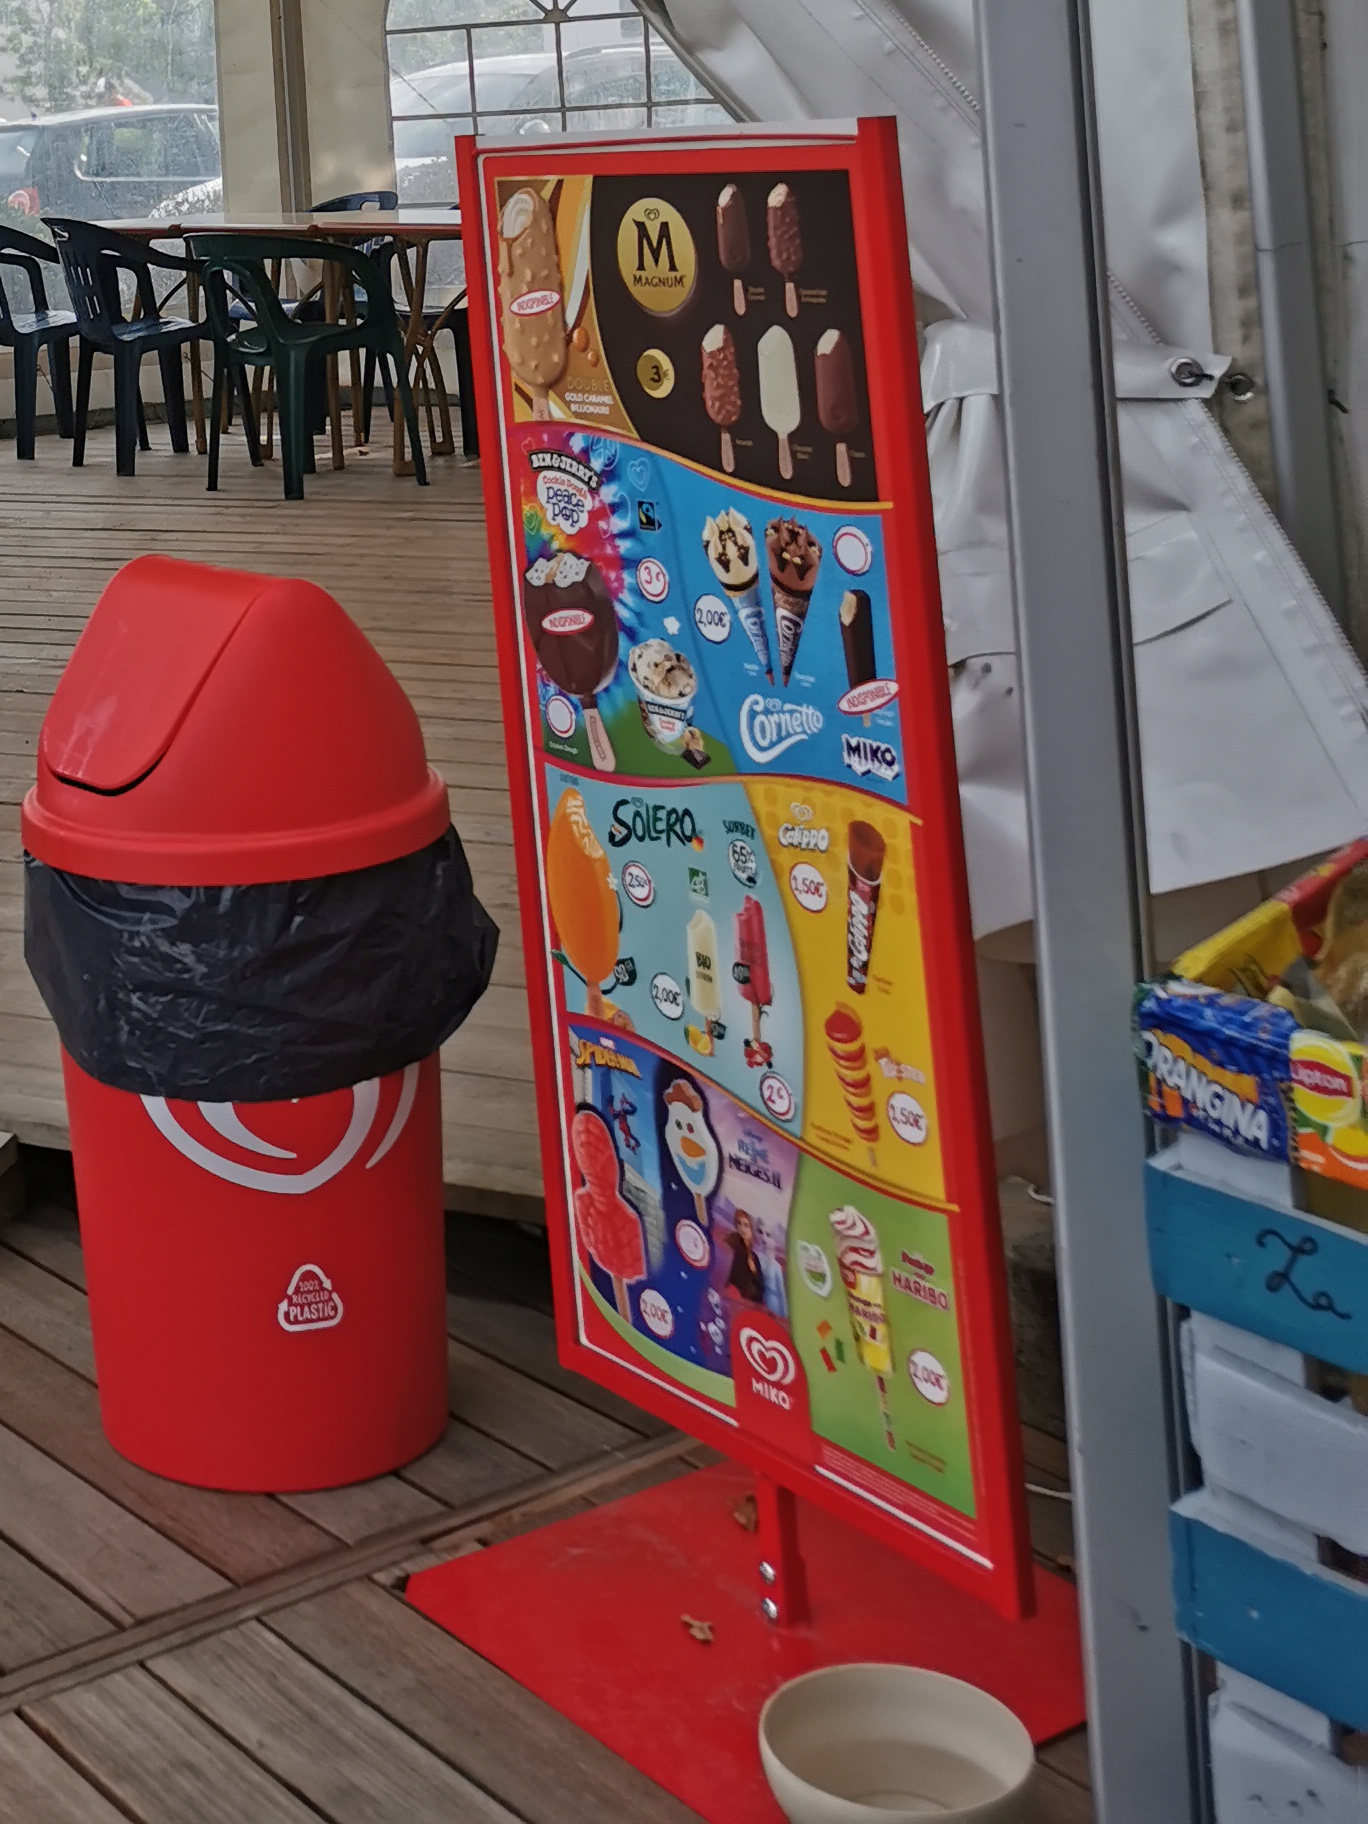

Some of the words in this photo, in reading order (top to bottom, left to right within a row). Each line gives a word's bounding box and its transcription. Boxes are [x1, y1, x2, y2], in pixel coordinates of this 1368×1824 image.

[632, 217, 679, 272] M
[633, 274, 686, 288] MAGNUM
[567, 376, 611, 392] DOUBLE
[696, 607, 727, 628] 2,00€
[739, 693, 824, 764] Cornetto
[846, 737, 896, 767] MIKO
[608, 798, 696, 848] SOLERO
[722, 819, 756, 841] SORBET
[778, 821, 829, 853] Calippo
[1142, 1030, 1270, 1151] ORANGINA
[892, 1270, 949, 1310] HARIBO
[289, 1302, 335, 1322] PLASTIC
[751, 1378, 791, 1410] MIKO
